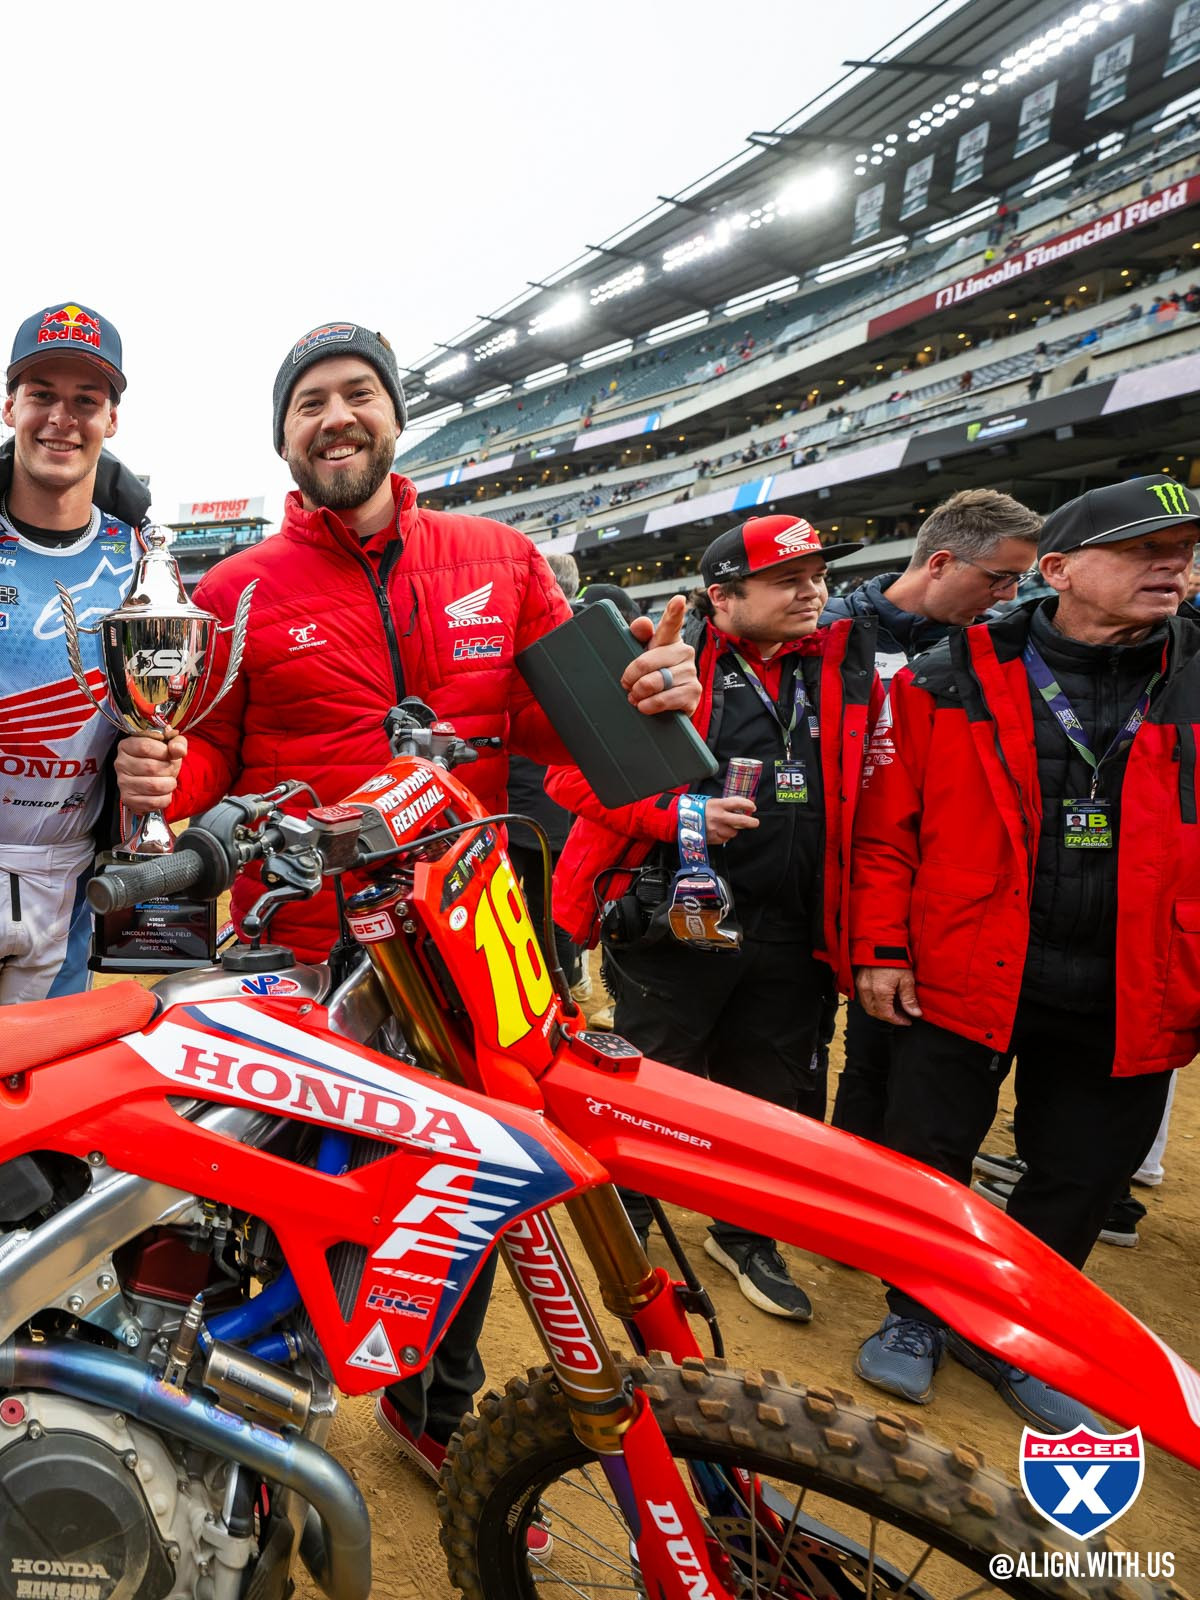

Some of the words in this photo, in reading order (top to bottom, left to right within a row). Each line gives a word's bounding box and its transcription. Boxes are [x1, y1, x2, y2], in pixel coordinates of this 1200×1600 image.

[954, 260, 1024, 302] Lincoln
[1023, 213, 1122, 270] Financial
[1121, 181, 1188, 230] Field
[37, 326, 70, 344] Red
[71, 327, 101, 350] Bull
[191, 499, 249, 515] FRSTRUST
[777, 544, 823, 556] HONDA
[448, 615, 503, 628] HONDA
[453, 635, 504, 656] HRC
[375, 765, 434, 813] RENTHAL
[791, 773, 805, 785] B
[12, 799, 60, 809] DUNLOP
[390, 785, 445, 836] RENTHAL
[1088, 813, 1108, 828] B
[1066, 836, 1109, 844] TRACK
[354, 919, 386, 935] GET
[474, 858, 554, 1049] 18
[243, 974, 280, 995] VP
[175, 1044, 482, 1155] HONDA
[612, 1108, 712, 1150] TRUETIMBER
[371, 1163, 531, 1261] CRF
[371, 1266, 460, 1291] 450R
[366, 1285, 436, 1316] HRC
[10, 1557, 111, 1580] HONDA
